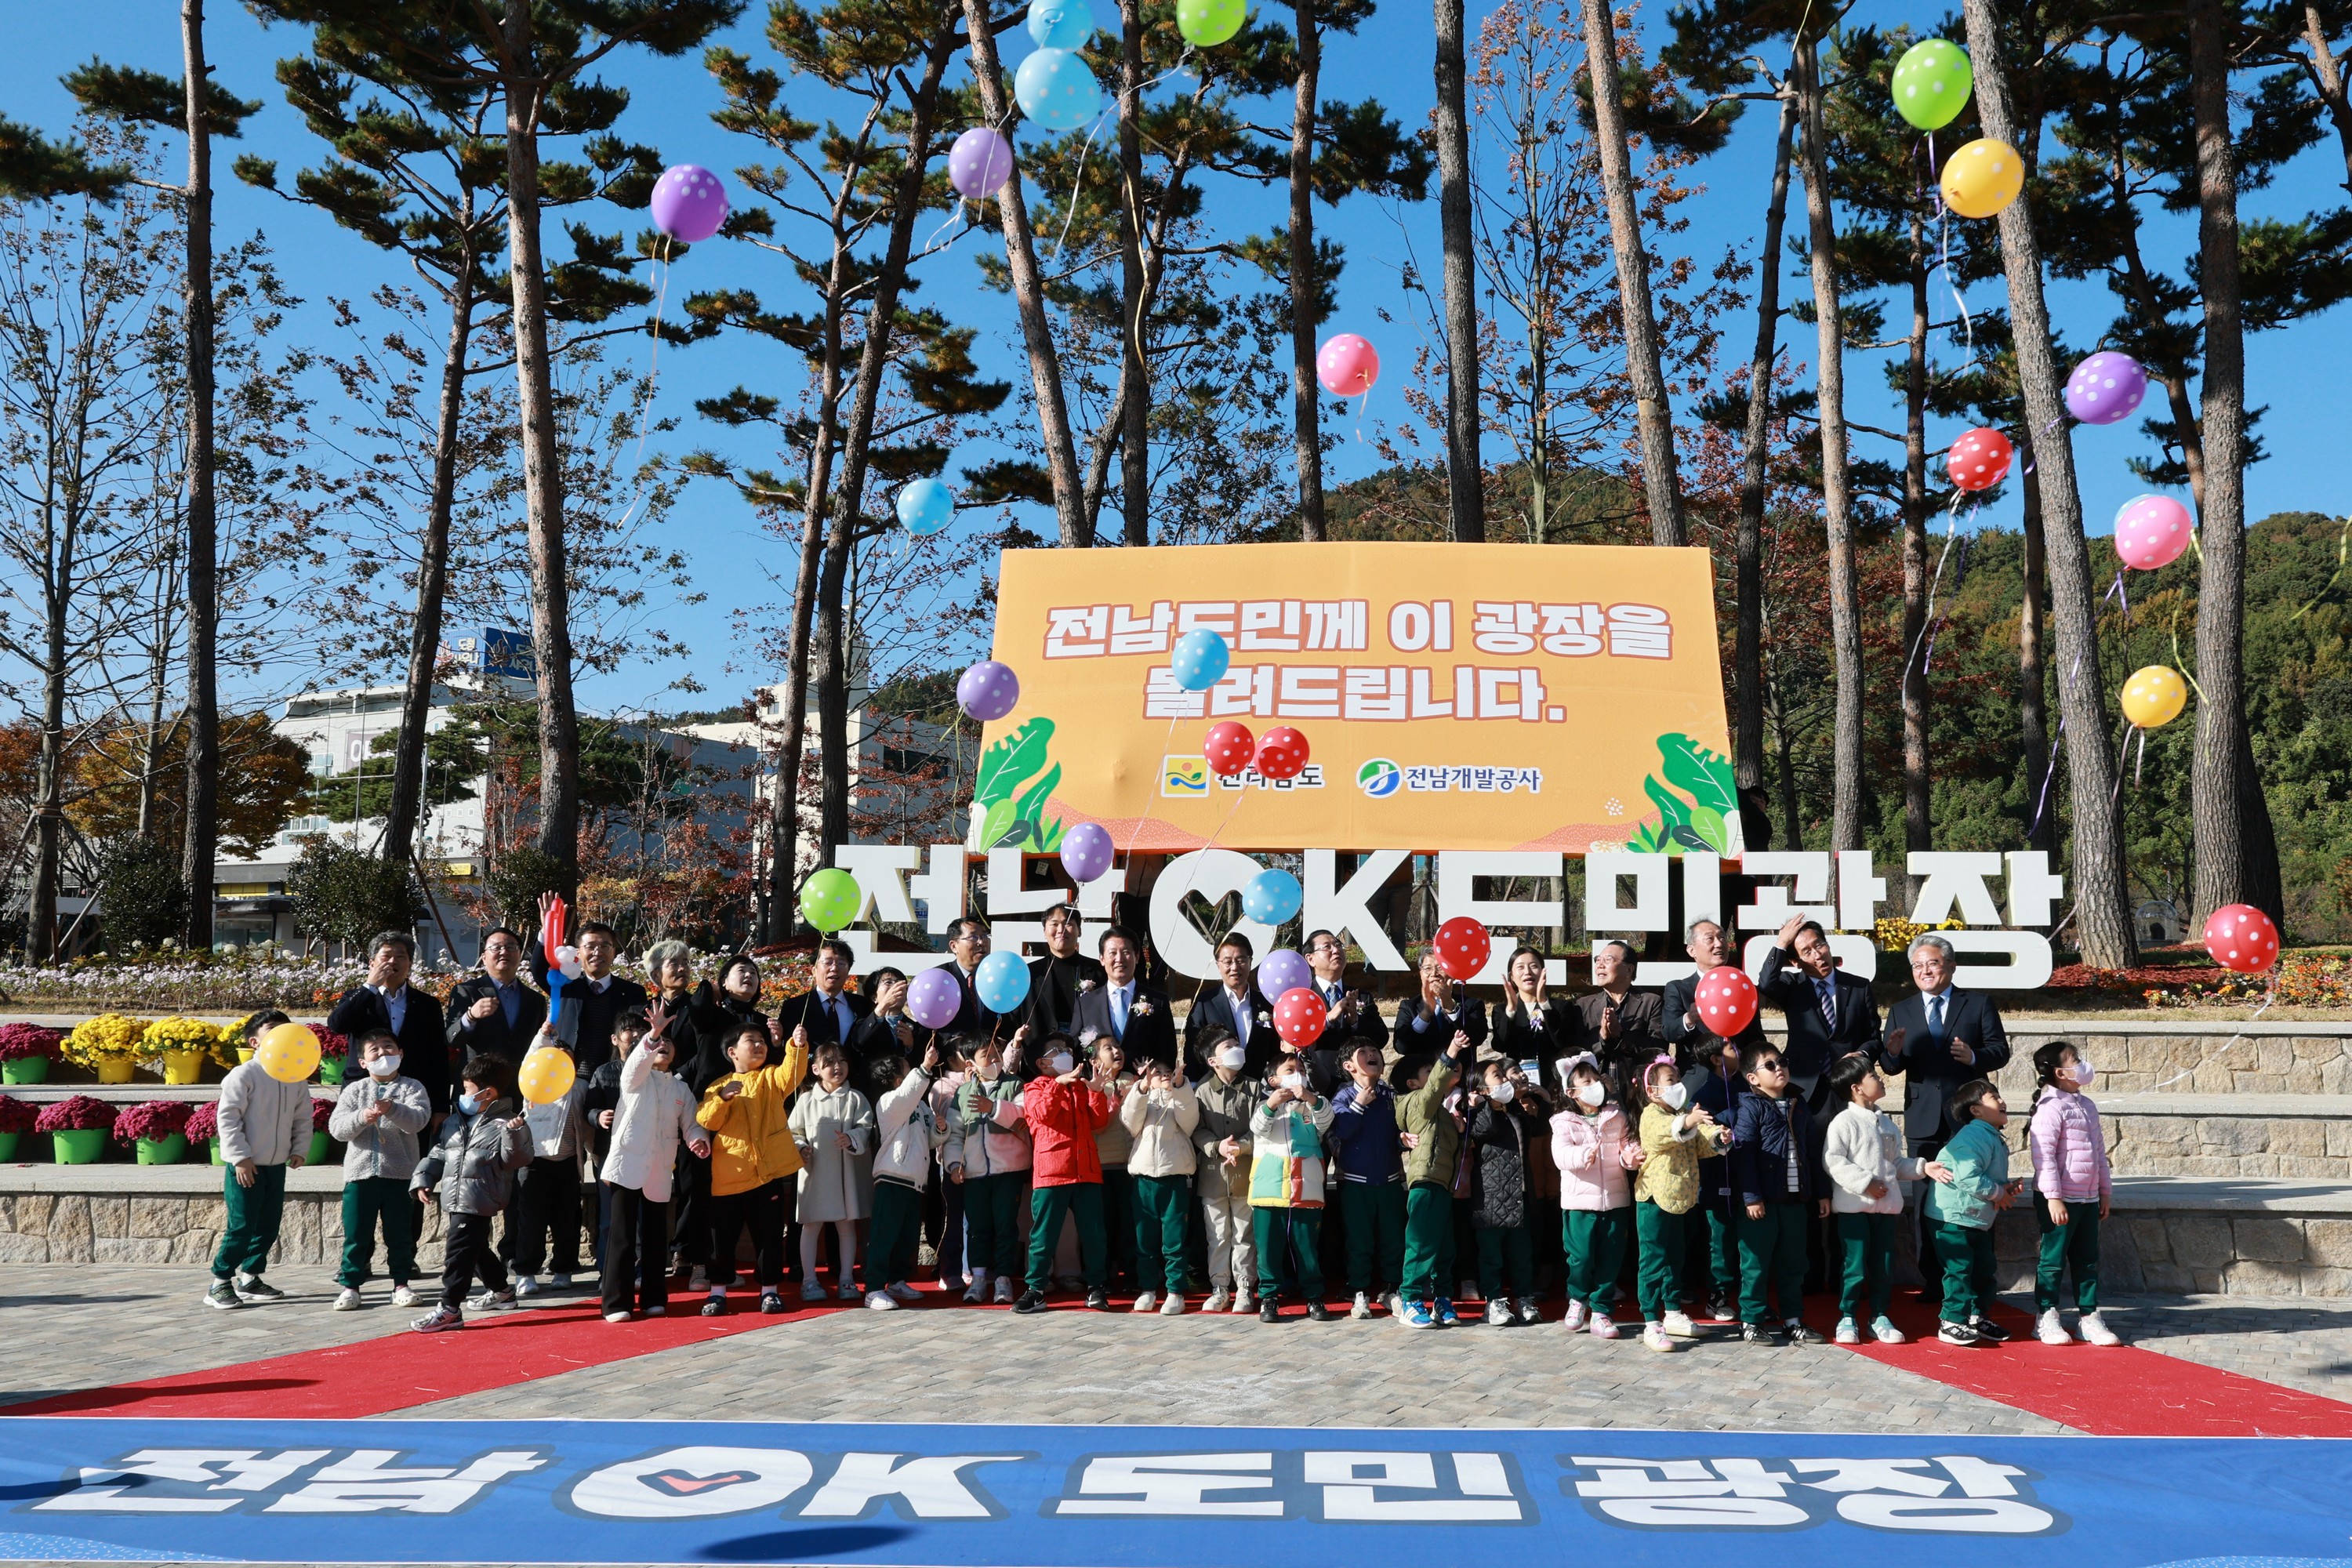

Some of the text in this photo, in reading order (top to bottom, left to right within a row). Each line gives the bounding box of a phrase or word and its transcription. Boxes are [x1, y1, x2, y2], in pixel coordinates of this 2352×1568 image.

[1045, 600, 1671, 659] 전남도민께 이 광장을
[1145, 666, 1565, 720] 돌려드립니다.
[1406, 768, 1541, 791] 전남개발공사
[32, 1446, 2054, 1534] 전남 OK 도민 광장
